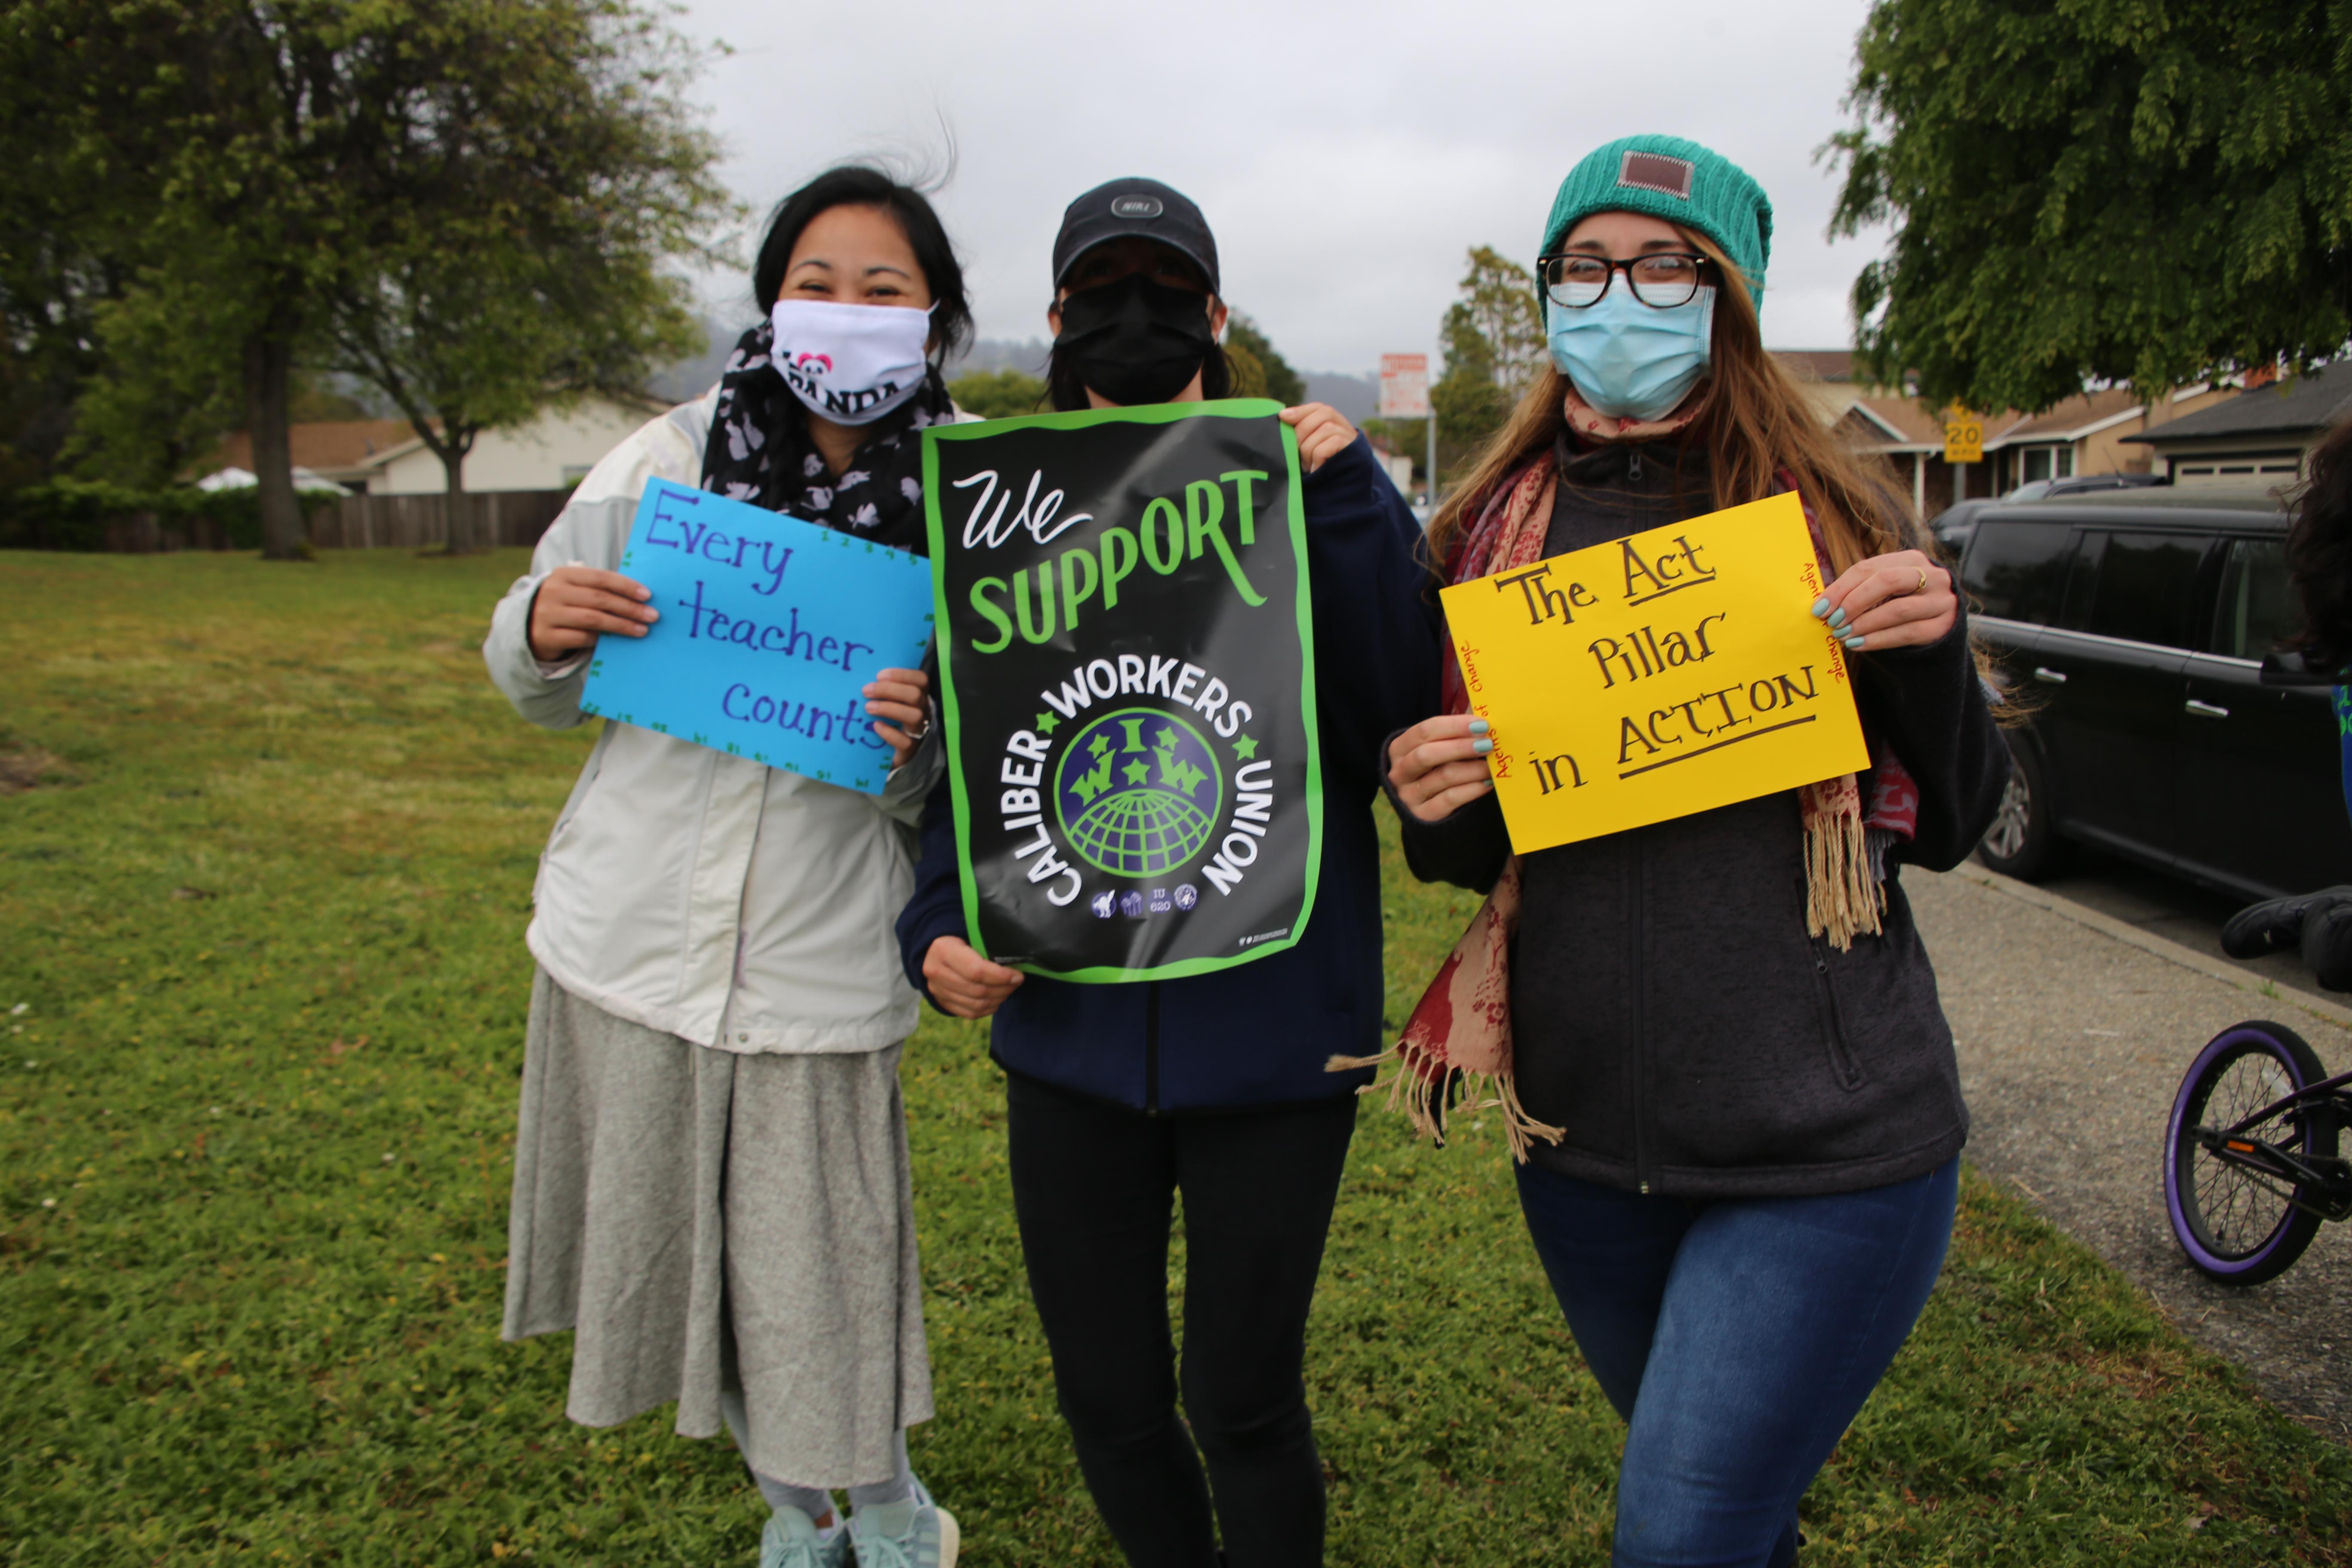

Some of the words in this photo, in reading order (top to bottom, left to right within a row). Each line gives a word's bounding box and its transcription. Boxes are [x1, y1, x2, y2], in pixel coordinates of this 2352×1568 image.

[1950, 426, 1978, 444] 20
[646, 489, 794, 595] Every
[952, 469, 1094, 549] We
[969, 469, 1268, 654] SUPPORT
[1494, 563, 1599, 625] The
[1616, 536, 1717, 599] Act
[679, 580, 874, 671] teacher
[1588, 612, 1727, 689] Pillar
[1041, 654, 1253, 738] WORKERS
[1474, 704, 1489, 717] of
[1528, 750, 1589, 796] in
[1616, 665, 1819, 765] ACTION
[1001, 730, 1082, 906] CALIBER
[1201, 760, 1274, 897] UNION
[1150, 900, 1171, 913] 620
[1153, 888, 1166, 899] IU
